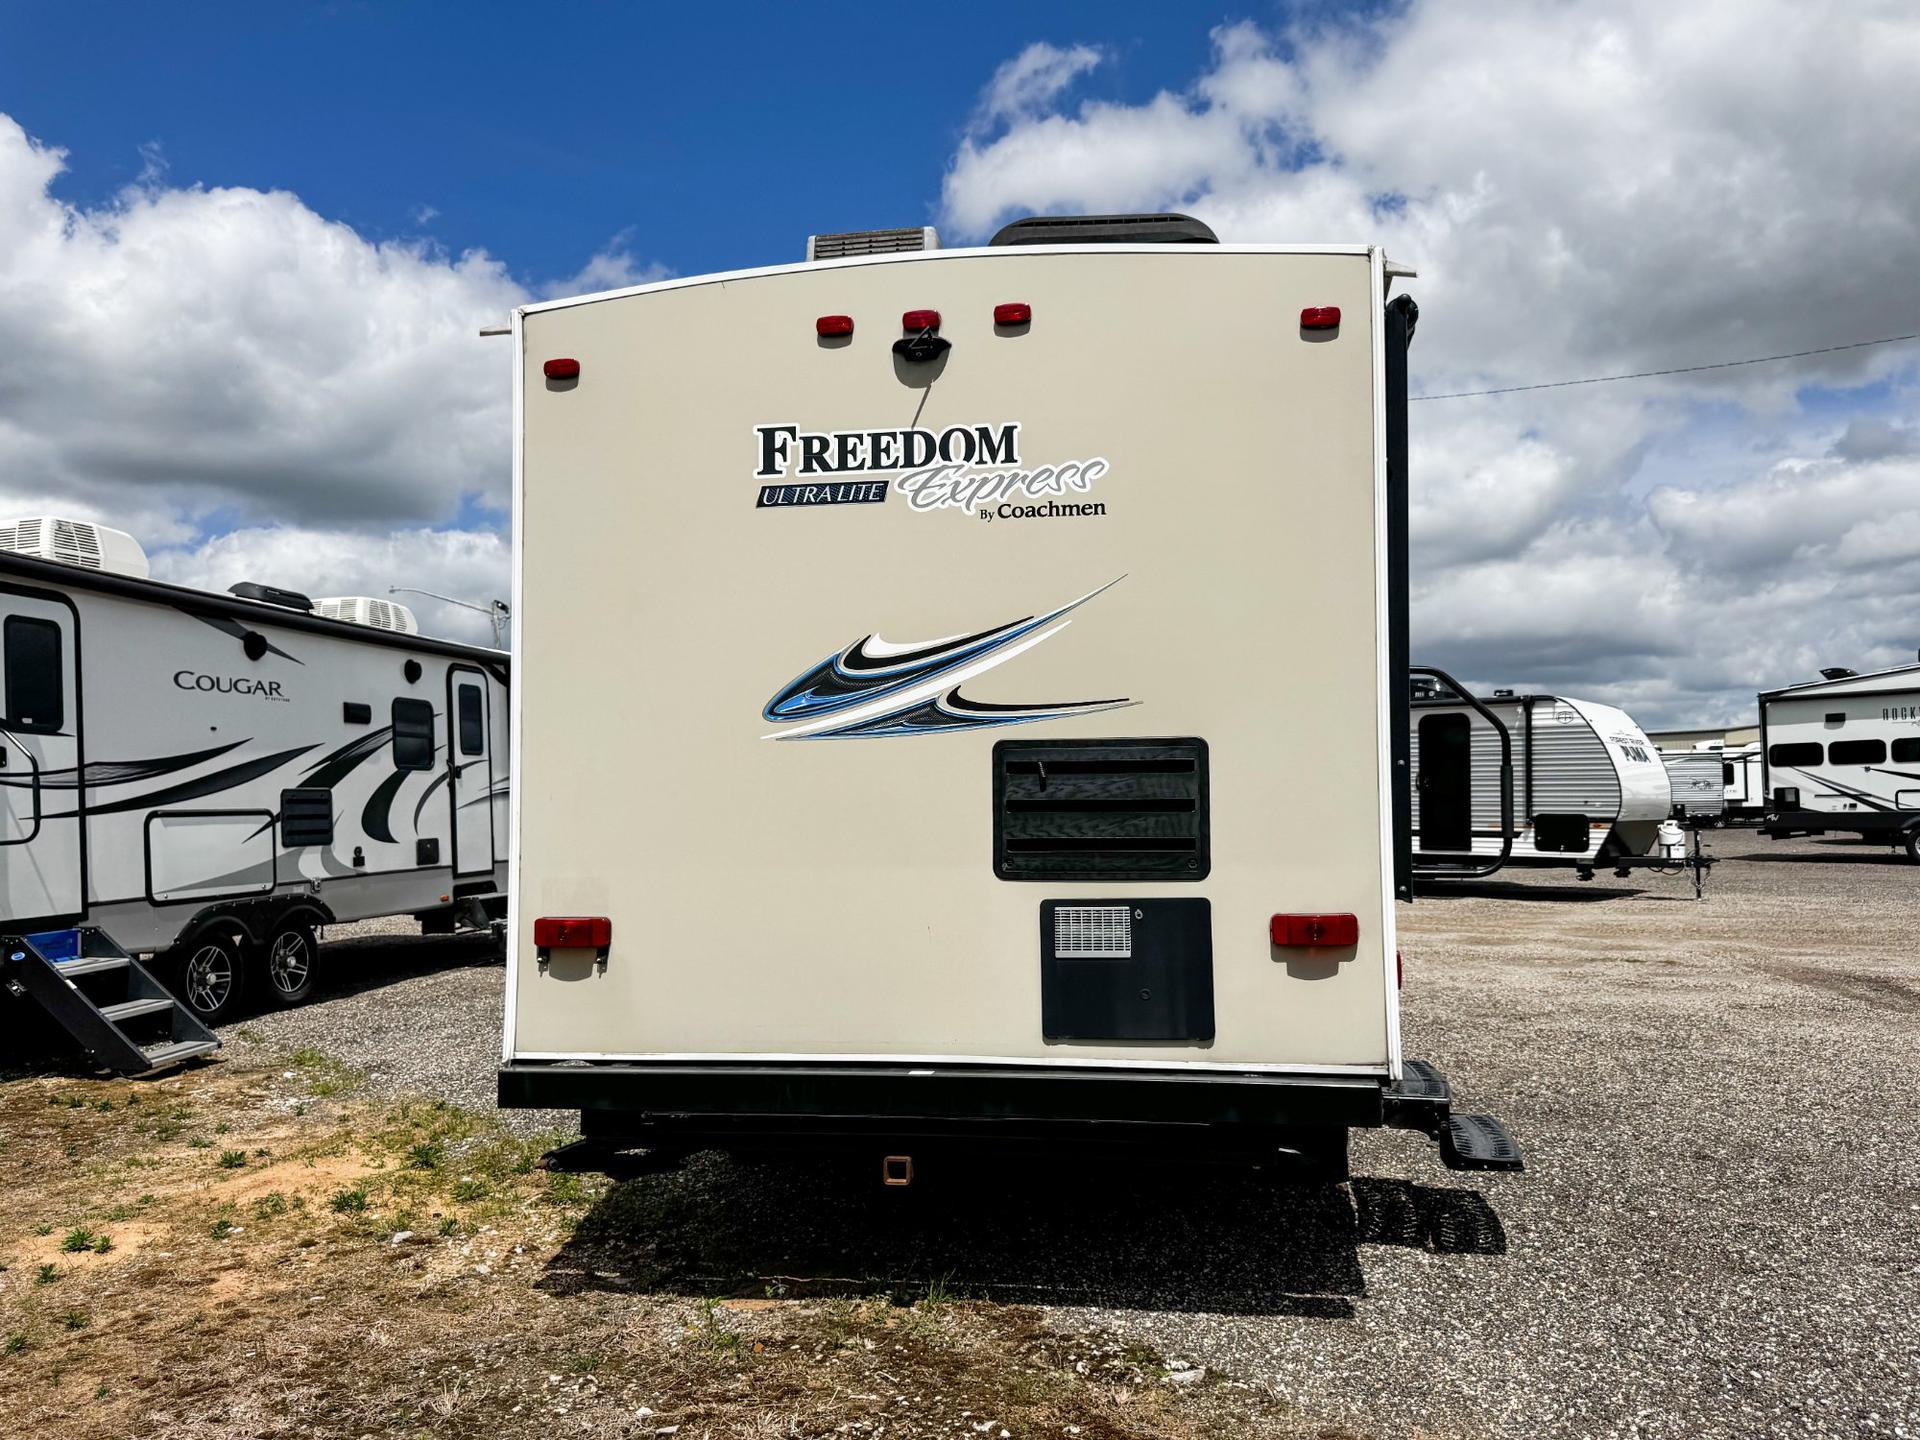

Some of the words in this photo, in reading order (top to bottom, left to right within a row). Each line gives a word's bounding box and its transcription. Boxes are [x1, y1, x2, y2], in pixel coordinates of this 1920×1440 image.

[757, 425, 1018, 475] FREEDOM
[897, 462, 1105, 511] Express
[980, 509, 995, 522] By
[998, 500, 1106, 519] Coachmen
[173, 670, 285, 697] COUGAR
[1882, 705, 1920, 721] ROCK
